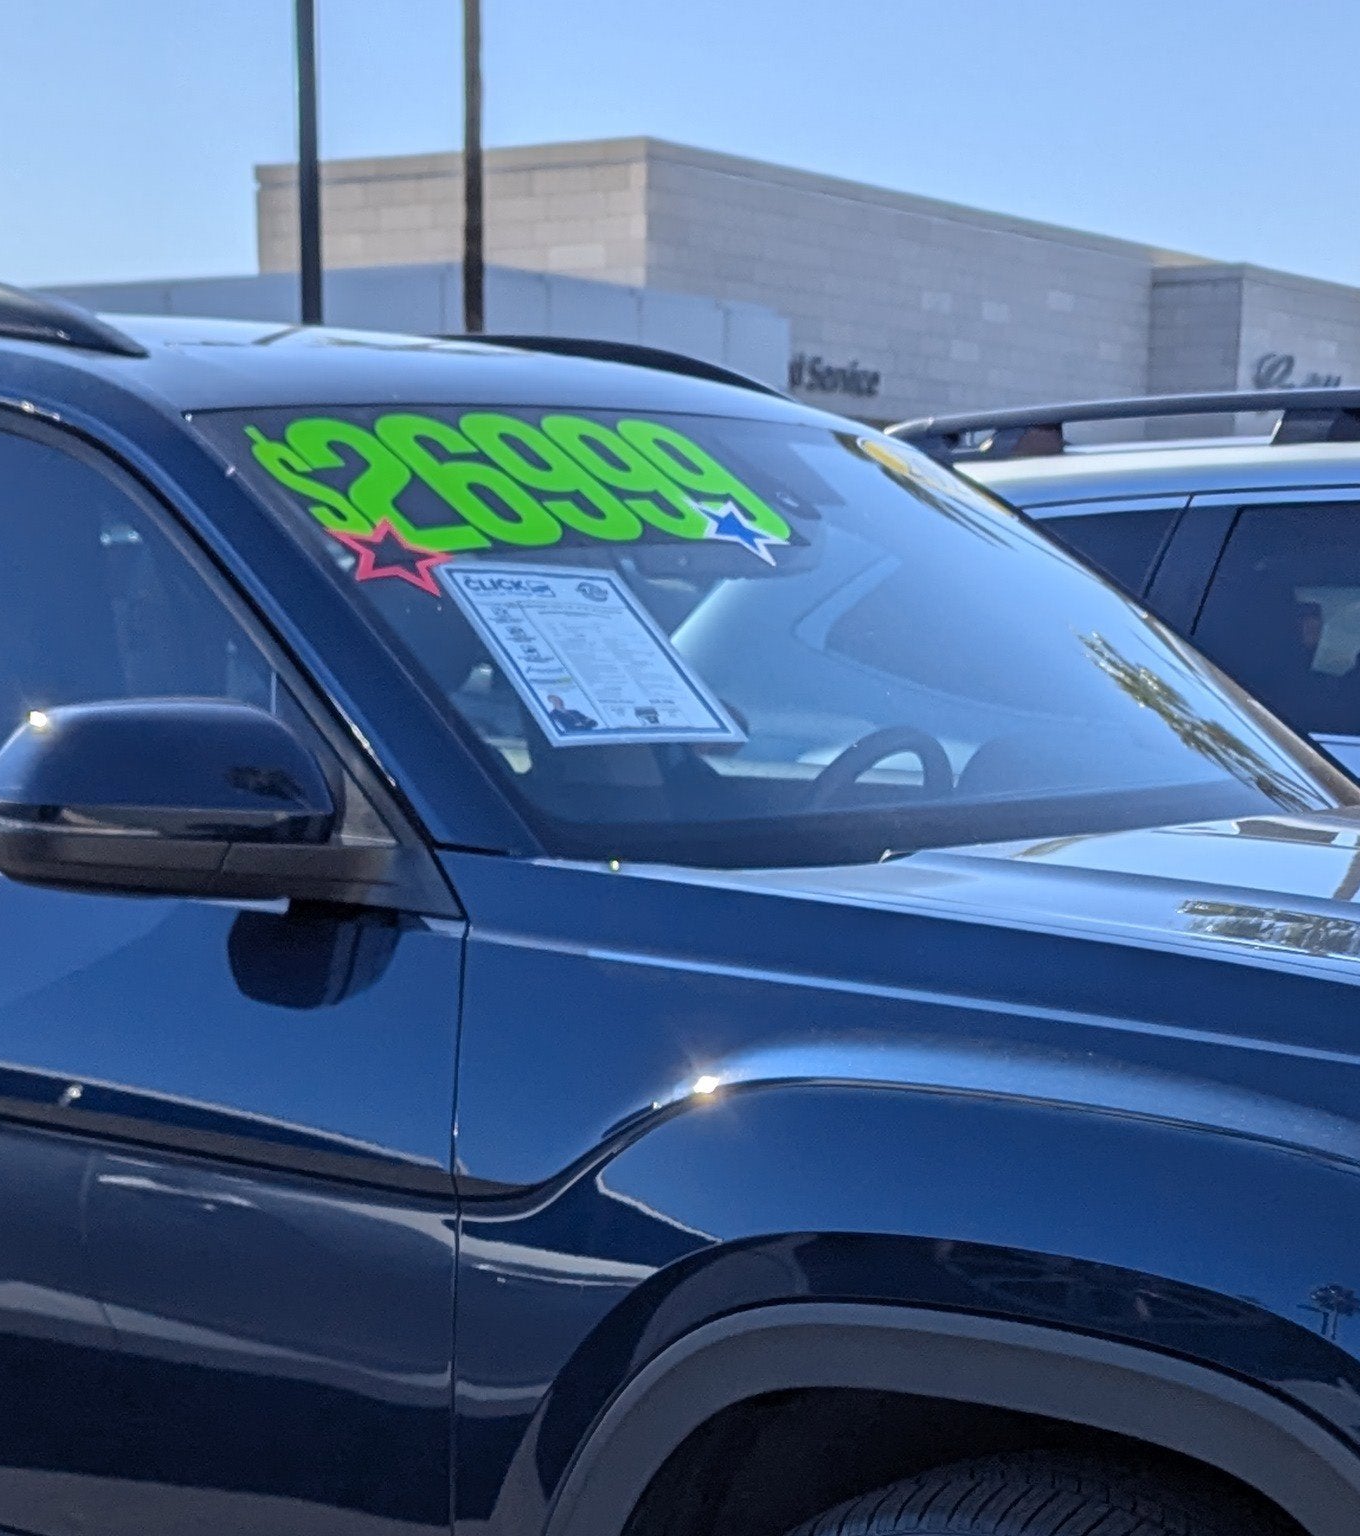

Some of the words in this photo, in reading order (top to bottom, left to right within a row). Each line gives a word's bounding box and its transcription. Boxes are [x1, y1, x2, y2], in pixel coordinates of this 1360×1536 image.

[804, 355, 881, 398] Service
[244, 413, 791, 552] $26999
[463, 575, 528, 593] CLICK
